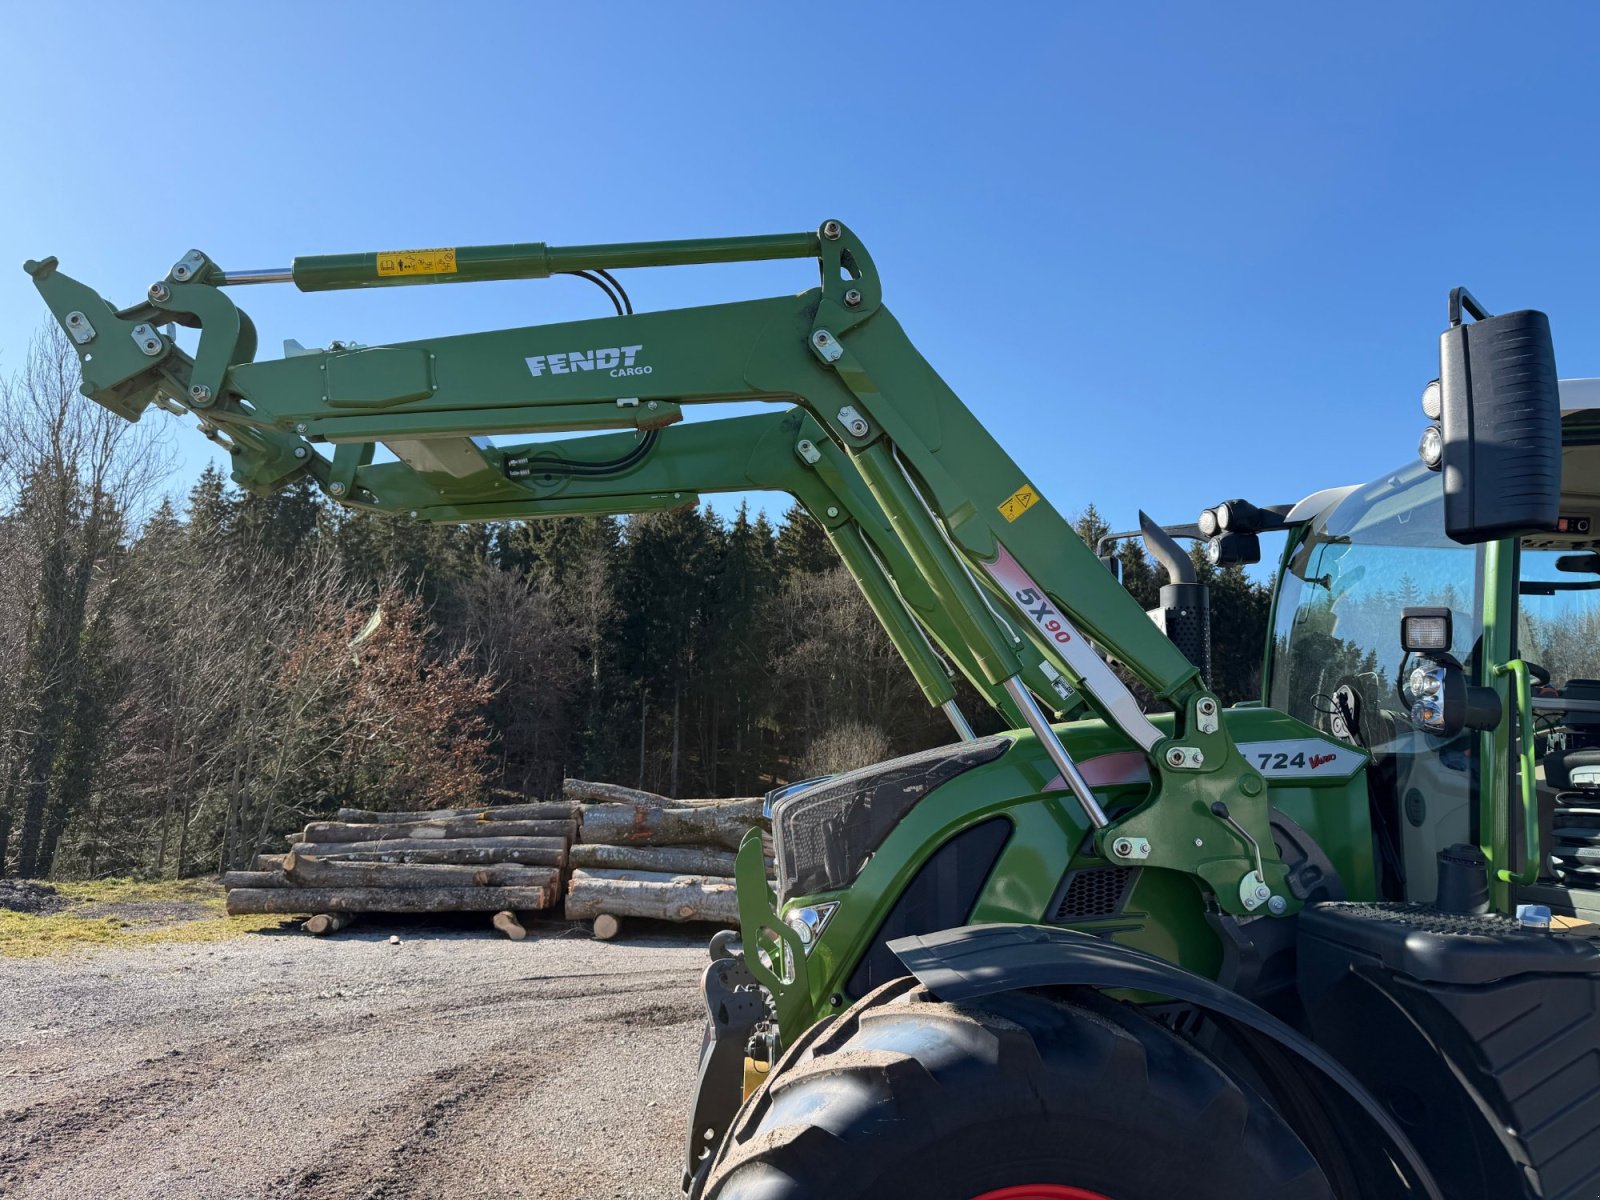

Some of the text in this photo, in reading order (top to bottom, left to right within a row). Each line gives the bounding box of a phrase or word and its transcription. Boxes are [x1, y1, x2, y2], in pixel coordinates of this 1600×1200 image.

[525, 344, 643, 377] FENDT
[609, 365, 653, 378] CARGO
[1015, 587, 1071, 643] 5X90
[1258, 752, 1306, 769] 724
